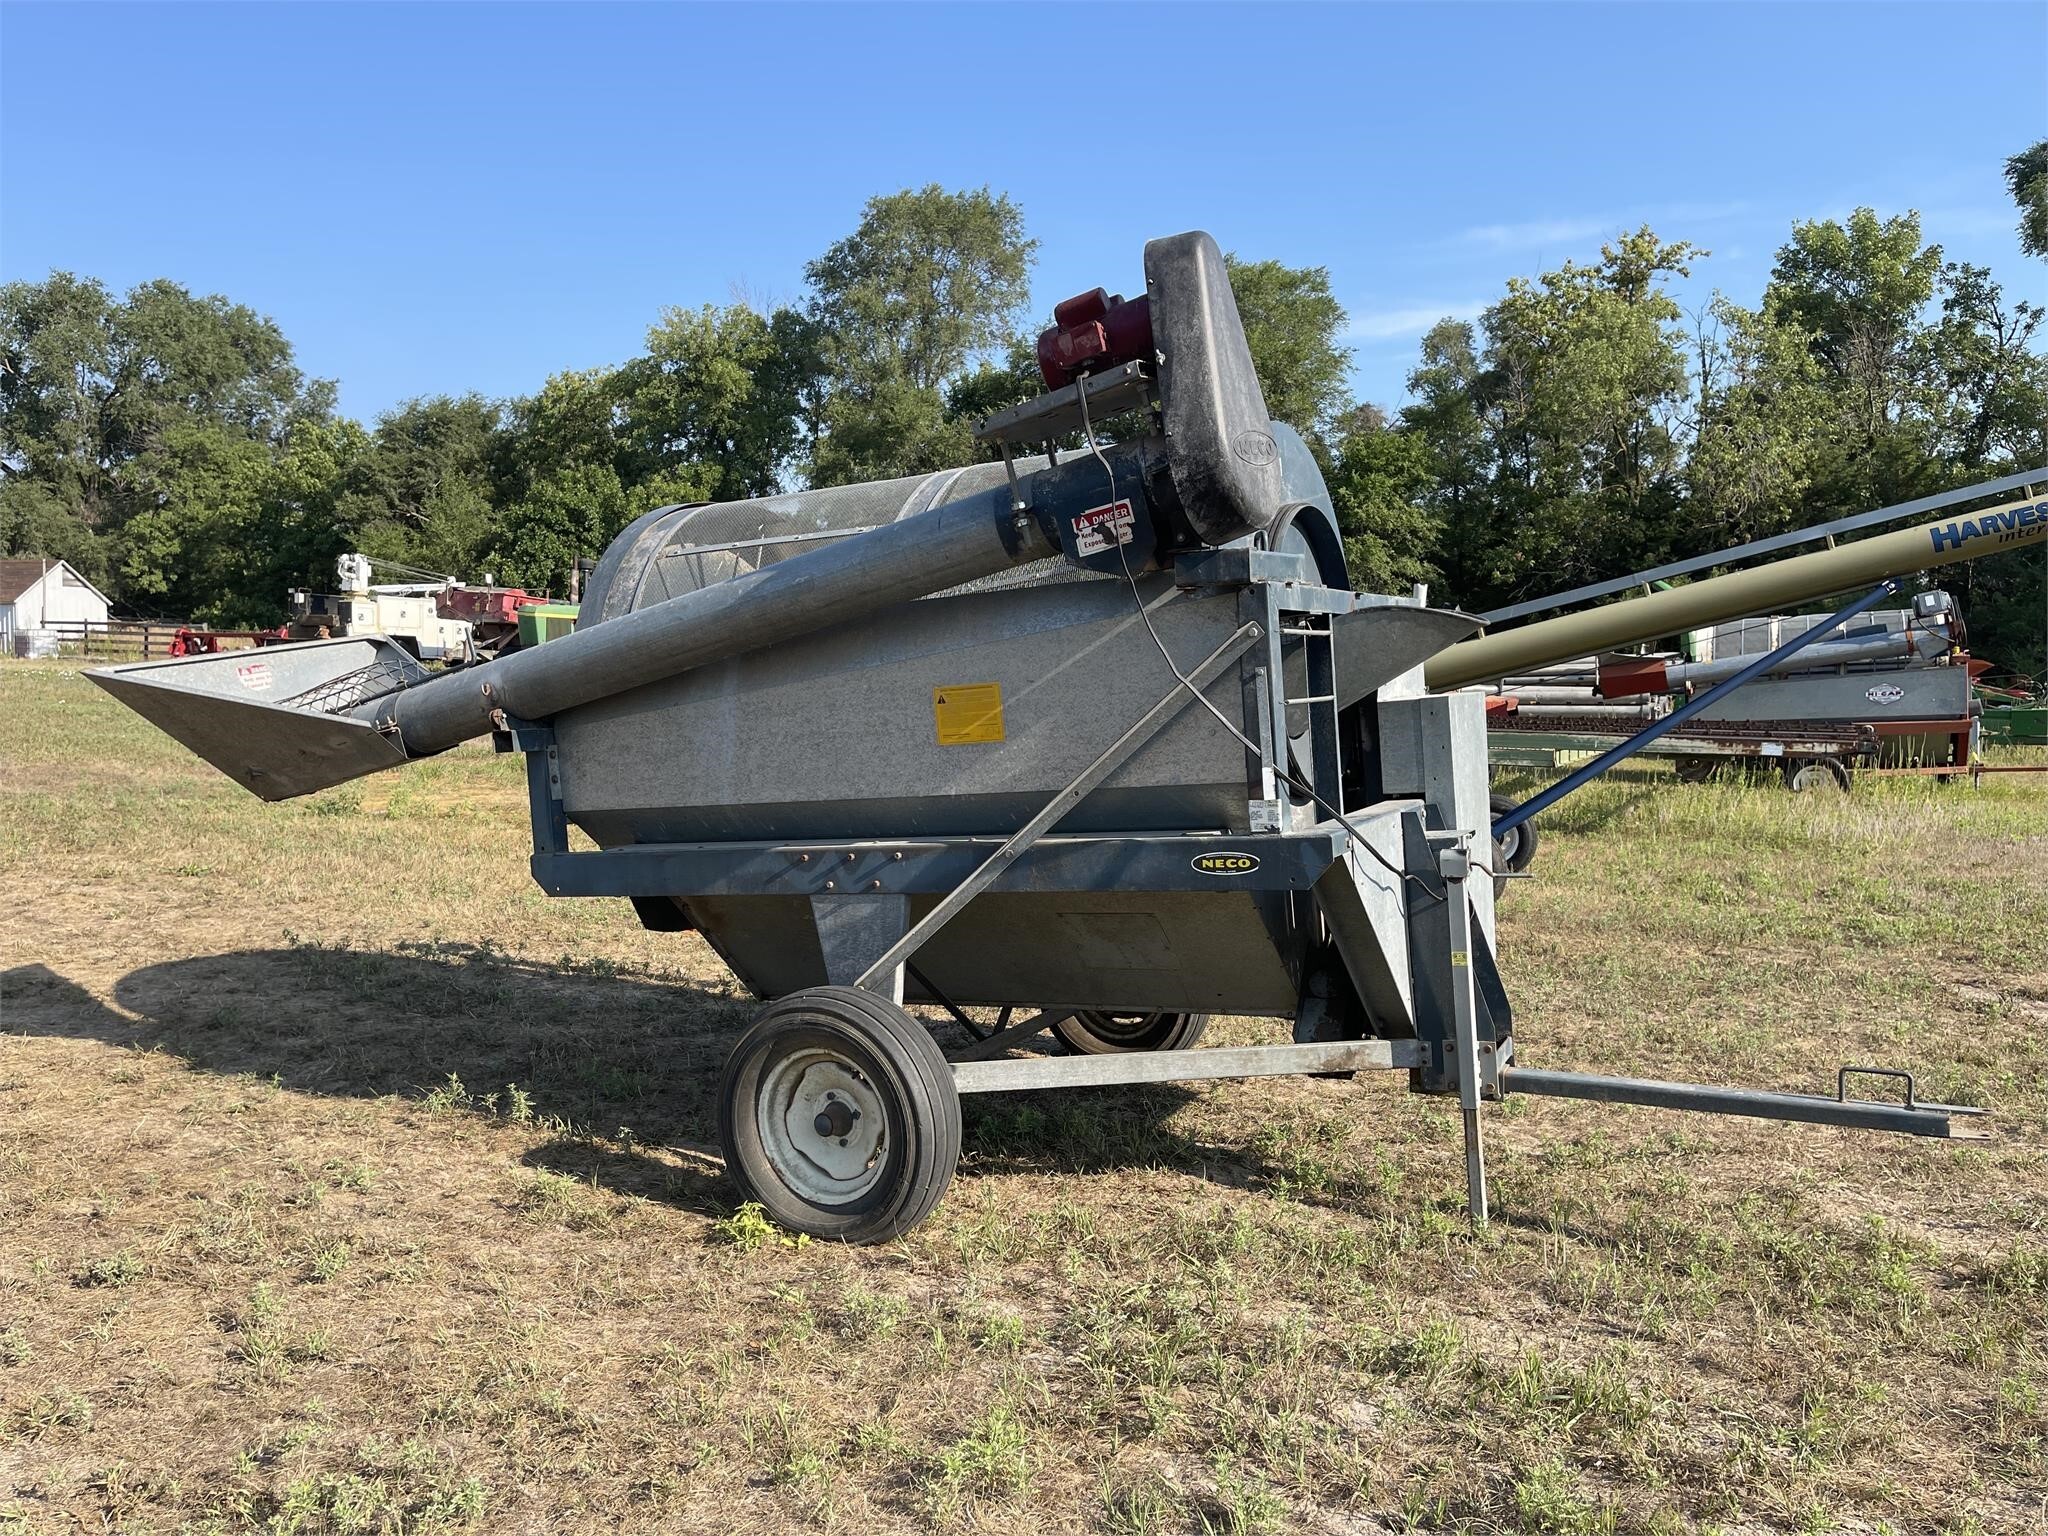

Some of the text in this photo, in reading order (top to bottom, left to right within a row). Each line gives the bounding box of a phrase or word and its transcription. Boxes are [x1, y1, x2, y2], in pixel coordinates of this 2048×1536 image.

[1238, 439, 1272, 457] NECO
[1081, 532, 1095, 540] Keep
[1202, 858, 1251, 868] NECO
